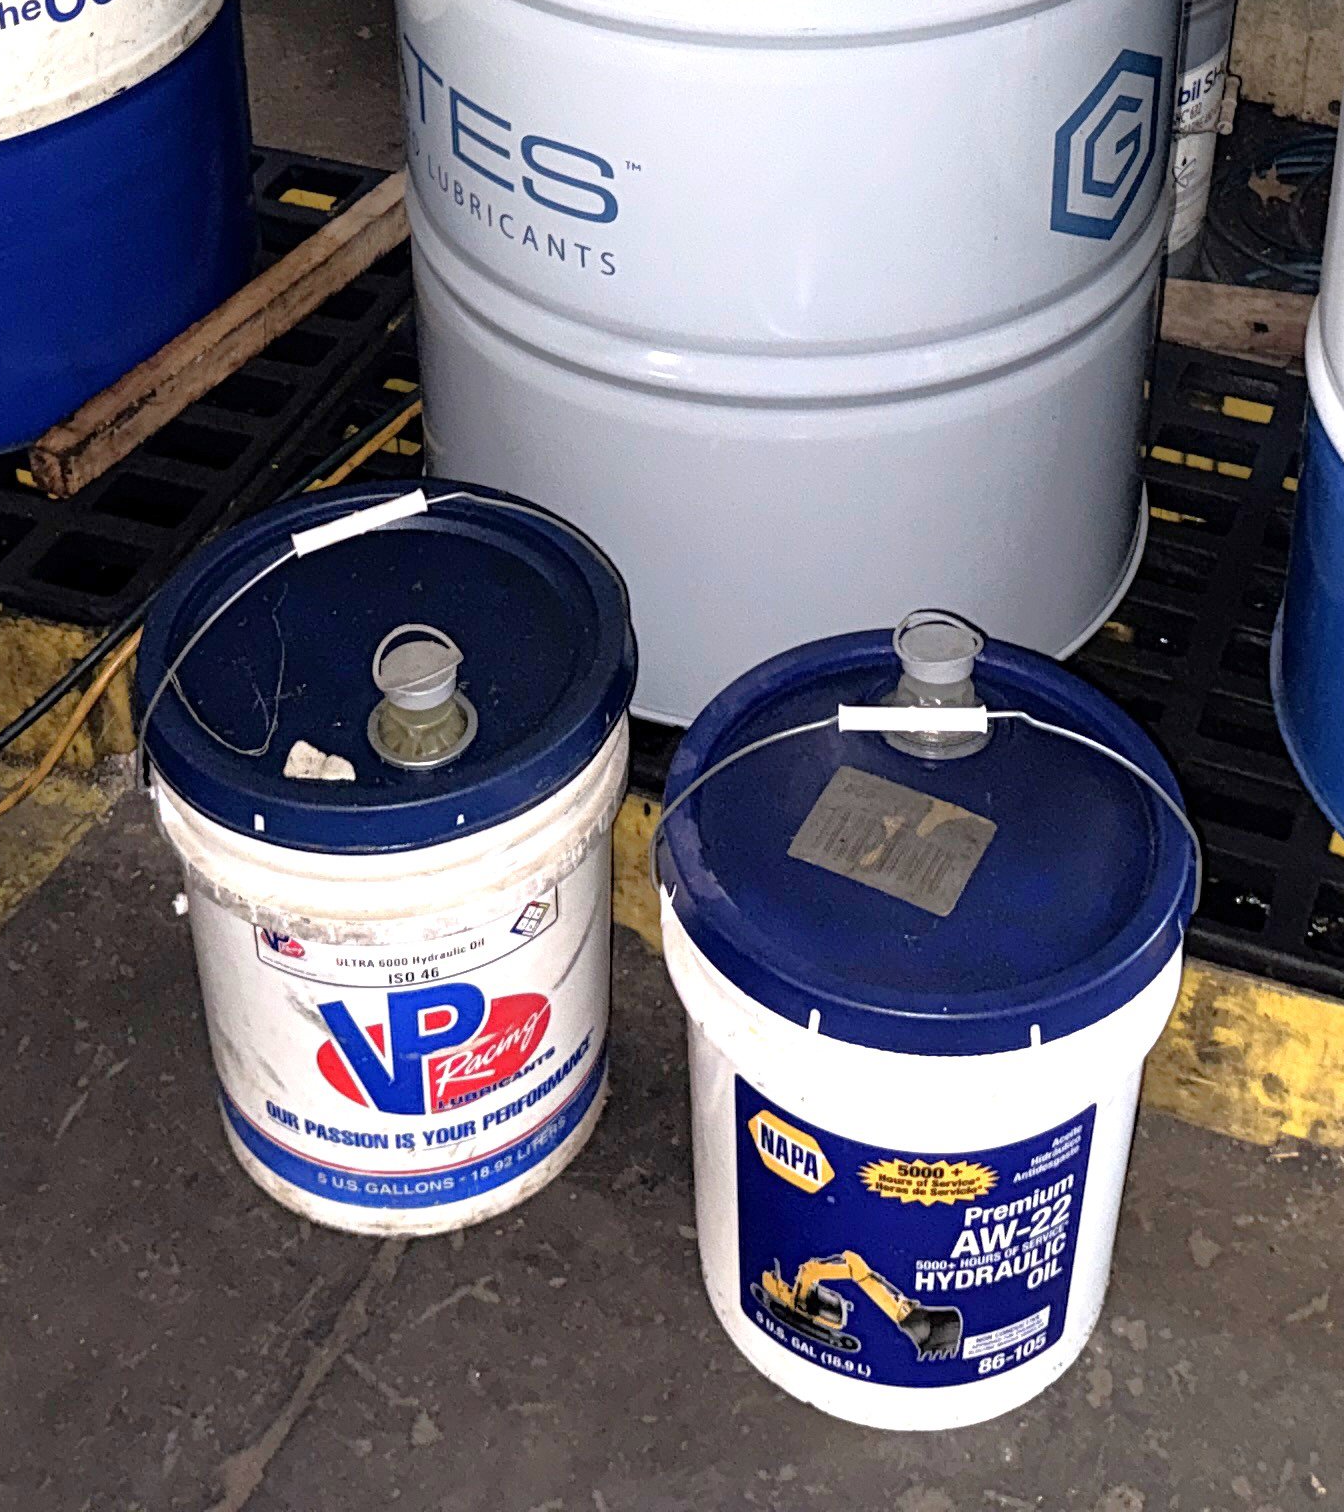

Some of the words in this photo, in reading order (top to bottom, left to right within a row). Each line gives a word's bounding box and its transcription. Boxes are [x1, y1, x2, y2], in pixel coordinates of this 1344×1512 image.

[1177, 78, 1201, 107] bil
[427, 154, 616, 276] LUBRICANTS
[335, 957, 375, 968] ULTRA
[378, 957, 409, 968] 6000
[412, 945, 467, 966] Hydraulic
[469, 937, 485, 951] Oil
[388, 972, 415, 985] ISO
[420, 966, 440, 980] 46
[317, 982, 486, 1116] VP
[435, 1002, 552, 1098] Racing
[438, 1045, 556, 1110] LUBRICANTS
[265, 1099, 301, 1131] OUR
[304, 1118, 389, 1149] PASSION
[395, 1132, 416, 1150] IS
[422, 1119, 477, 1147] YOUR
[759, 1122, 820, 1181] NAPA
[897, 1164, 945, 1179] 5000
[332, 1175, 358, 1192] US
[365, 1176, 455, 1195] GALLONS
[878, 1174, 913, 1187] Hours
[964, 1173, 1075, 1227] Premium
[950, 1193, 1072, 1259] AW-22
[914, 1232, 1067, 1292] HYDRAULIC
[959, 1250, 1002, 1268] HOURS
[1004, 1244, 1020, 1259] OF
[1027, 1258, 1063, 1290] OIL
[790, 1335, 817, 1359] GAL
[977, 1330, 1048, 1375] 86-105
